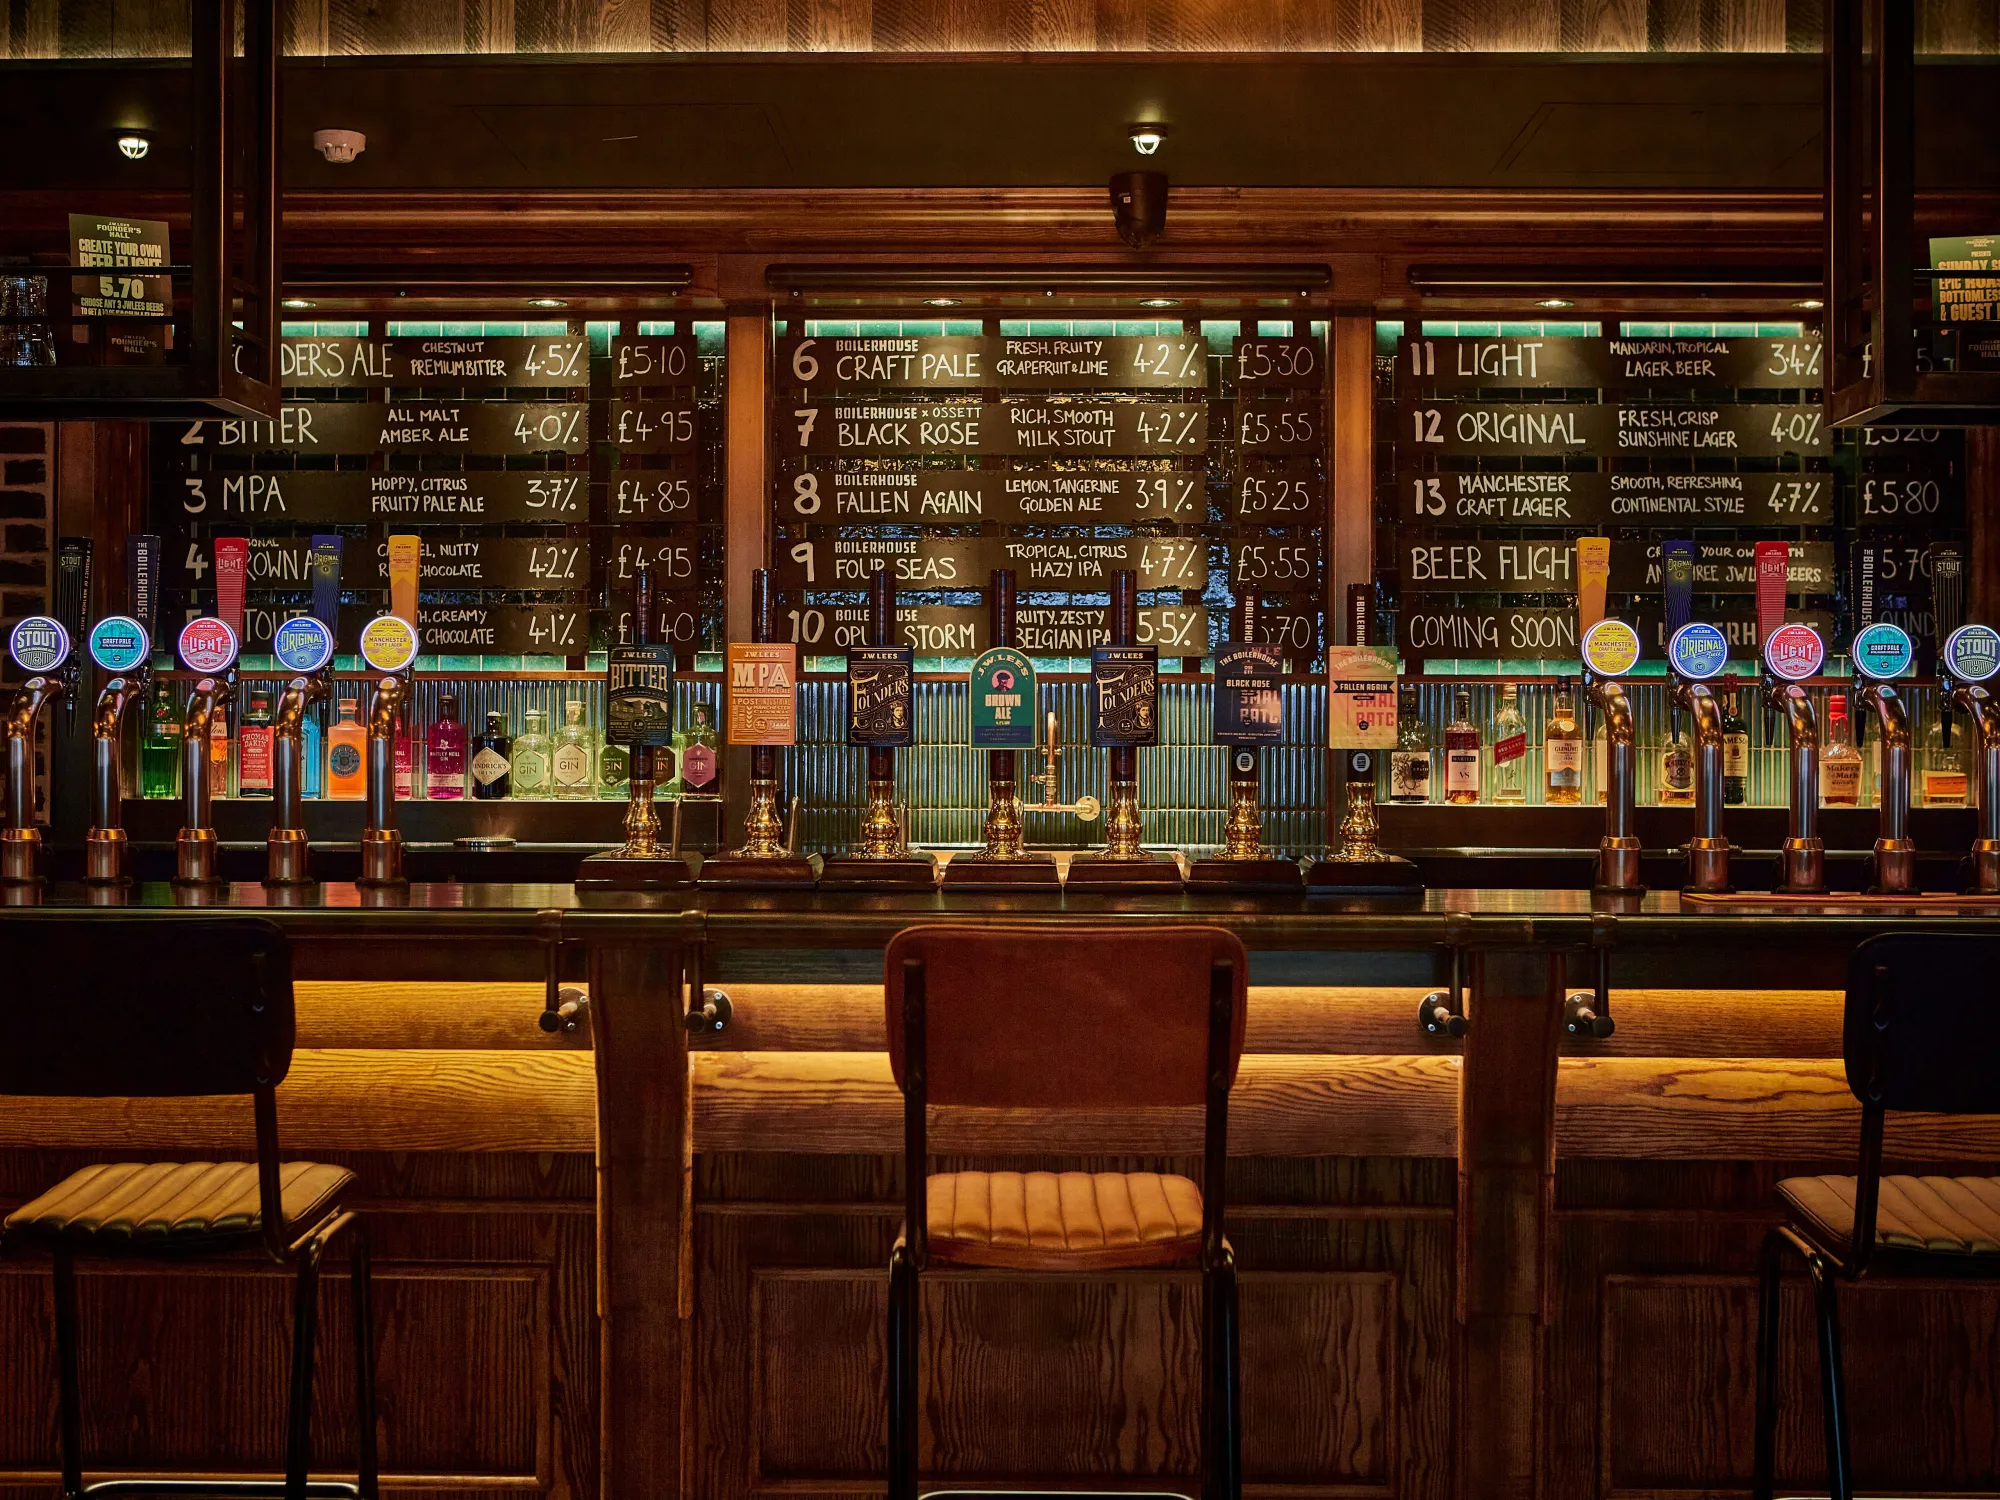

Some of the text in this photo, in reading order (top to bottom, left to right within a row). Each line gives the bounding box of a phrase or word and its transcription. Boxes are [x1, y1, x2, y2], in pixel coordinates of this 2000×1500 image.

[97, 224, 141, 234] FOUNDER'S
[79, 239, 161, 258] CREATE YOUR OWN
[100, 276, 144, 299] 5.70
[1939, 278, 1961, 289] EPIC
[81, 297, 103, 308] CHOOSE
[104, 299, 116, 309] ANY
[117, 300, 121, 309] 3
[146, 302, 164, 311] BEERS
[1951, 303, 1992, 320] GUEST
[422, 342, 484, 354] CHESTNUT
[836, 340, 918, 352] BOILERHOUSE
[1054, 340, 1102, 355] FRUITY
[1676, 341, 1730, 354] TROPICAL
[351, 343, 394, 378] ALE
[525, 342, 582, 377] 4.5%
[619, 346, 686, 379] £5.10
[793, 340, 819, 381] 6
[836, 354, 980, 381] CRAFT PALE
[1238, 344, 1313, 380] £5.30
[1411, 341, 1435, 376] 11
[1458, 343, 1544, 378] LIGHT
[996, 360, 1068, 375] GRAPEFRUIT
[1080, 360, 1108, 376] LIME
[1625, 361, 1716, 377] LAGER BEER
[388, 409, 459, 422] ALL MALT
[835, 407, 982, 419] BOILERHOUSE OSSETT
[1011, 408, 1113, 426] RICH, SMOOTH
[1677, 411, 1718, 426] CRISP
[514, 410, 580, 444] 4.0%
[619, 410, 692, 443] £4.95
[794, 408, 819, 447] 7
[838, 422, 980, 446] BLACK ROSE
[1241, 412, 1313, 444] £5.55
[1413, 409, 1444, 443] 12
[1457, 411, 1586, 444] ORIGINAL
[380, 428, 469, 444] AMBER ALE
[1017, 429, 1115, 447] MILK STOUT
[1619, 431, 1738, 448] SUNSHINE LAGER
[372, 477, 468, 493] HOPPY, CITRUS
[835, 474, 917, 486] BOILERHOUSE
[1053, 478, 1120, 494] TANGERINE
[1459, 475, 1571, 494] MANCHESTER
[1667, 476, 1742, 490] REFRESHING
[184, 479, 206, 513] 3
[223, 476, 286, 512] MPA
[618, 480, 690, 514] £4.85
[793, 472, 821, 515] 8
[836, 490, 982, 514] FALLEN AGAIN
[1240, 477, 1309, 514] £5.25
[1413, 479, 1446, 516] 13
[1864, 481, 1939, 514] £5.80
[372, 496, 484, 512] FRUITY PALE ALE
[1020, 497, 1102, 513] GOLDEN ALE
[1456, 497, 1571, 518] CRAFT LAGER
[1611, 497, 1744, 514] CONTINENTAL STYLE
[440, 543, 479, 556] NUTTY
[834, 541, 917, 554] BOILERHOUSE
[1079, 543, 1127, 559] CITRUS
[1701, 546, 1734, 558] YOUR
[61, 556, 81, 566] STOUT
[185, 543, 209, 580] 4
[218, 558, 241, 570] LIGHT
[313, 553, 339, 566] ORIGINAL
[791, 541, 815, 583] 9
[896, 557, 957, 580] SEAS
[1238, 545, 1310, 582] £5.55
[1411, 546, 1487, 580] BEER
[1030, 562, 1103, 578] HAZY IPA
[138, 550, 148, 618] BOILERHOUSE
[1861, 556, 1873, 627] BOILERHOUSE
[433, 610, 487, 624] CREAMY
[1060, 610, 1105, 625] ZESTY
[788, 609, 825, 644] 10
[1410, 615, 1499, 649] COMING
[1511, 615, 1575, 648] SOON
[17, 631, 56, 649] STOUT
[190, 636, 223, 654] LIGHT
[281, 631, 323, 652] ORIGINAL
[426, 628, 494, 645] CHOCOLATE
[904, 623, 975, 650] STORM
[1680, 637, 1722, 658] ORIGINAL
[1780, 643, 1814, 661] LIGHT
[1957, 639, 1997, 657] STOUT
[1219, 651, 1279, 668] THE BOILERHOUSE
[610, 664, 668, 692] BITTER
[733, 663, 790, 687] MPA
[1252, 680, 1271, 688] ROSE
[1340, 683, 1388, 691] FALLEN AGAIN
[985, 694, 1021, 706] BROWN
[995, 707, 1011, 719] ALE
[519, 766, 537, 774] GIN
[559, 762, 579, 770] GIN
